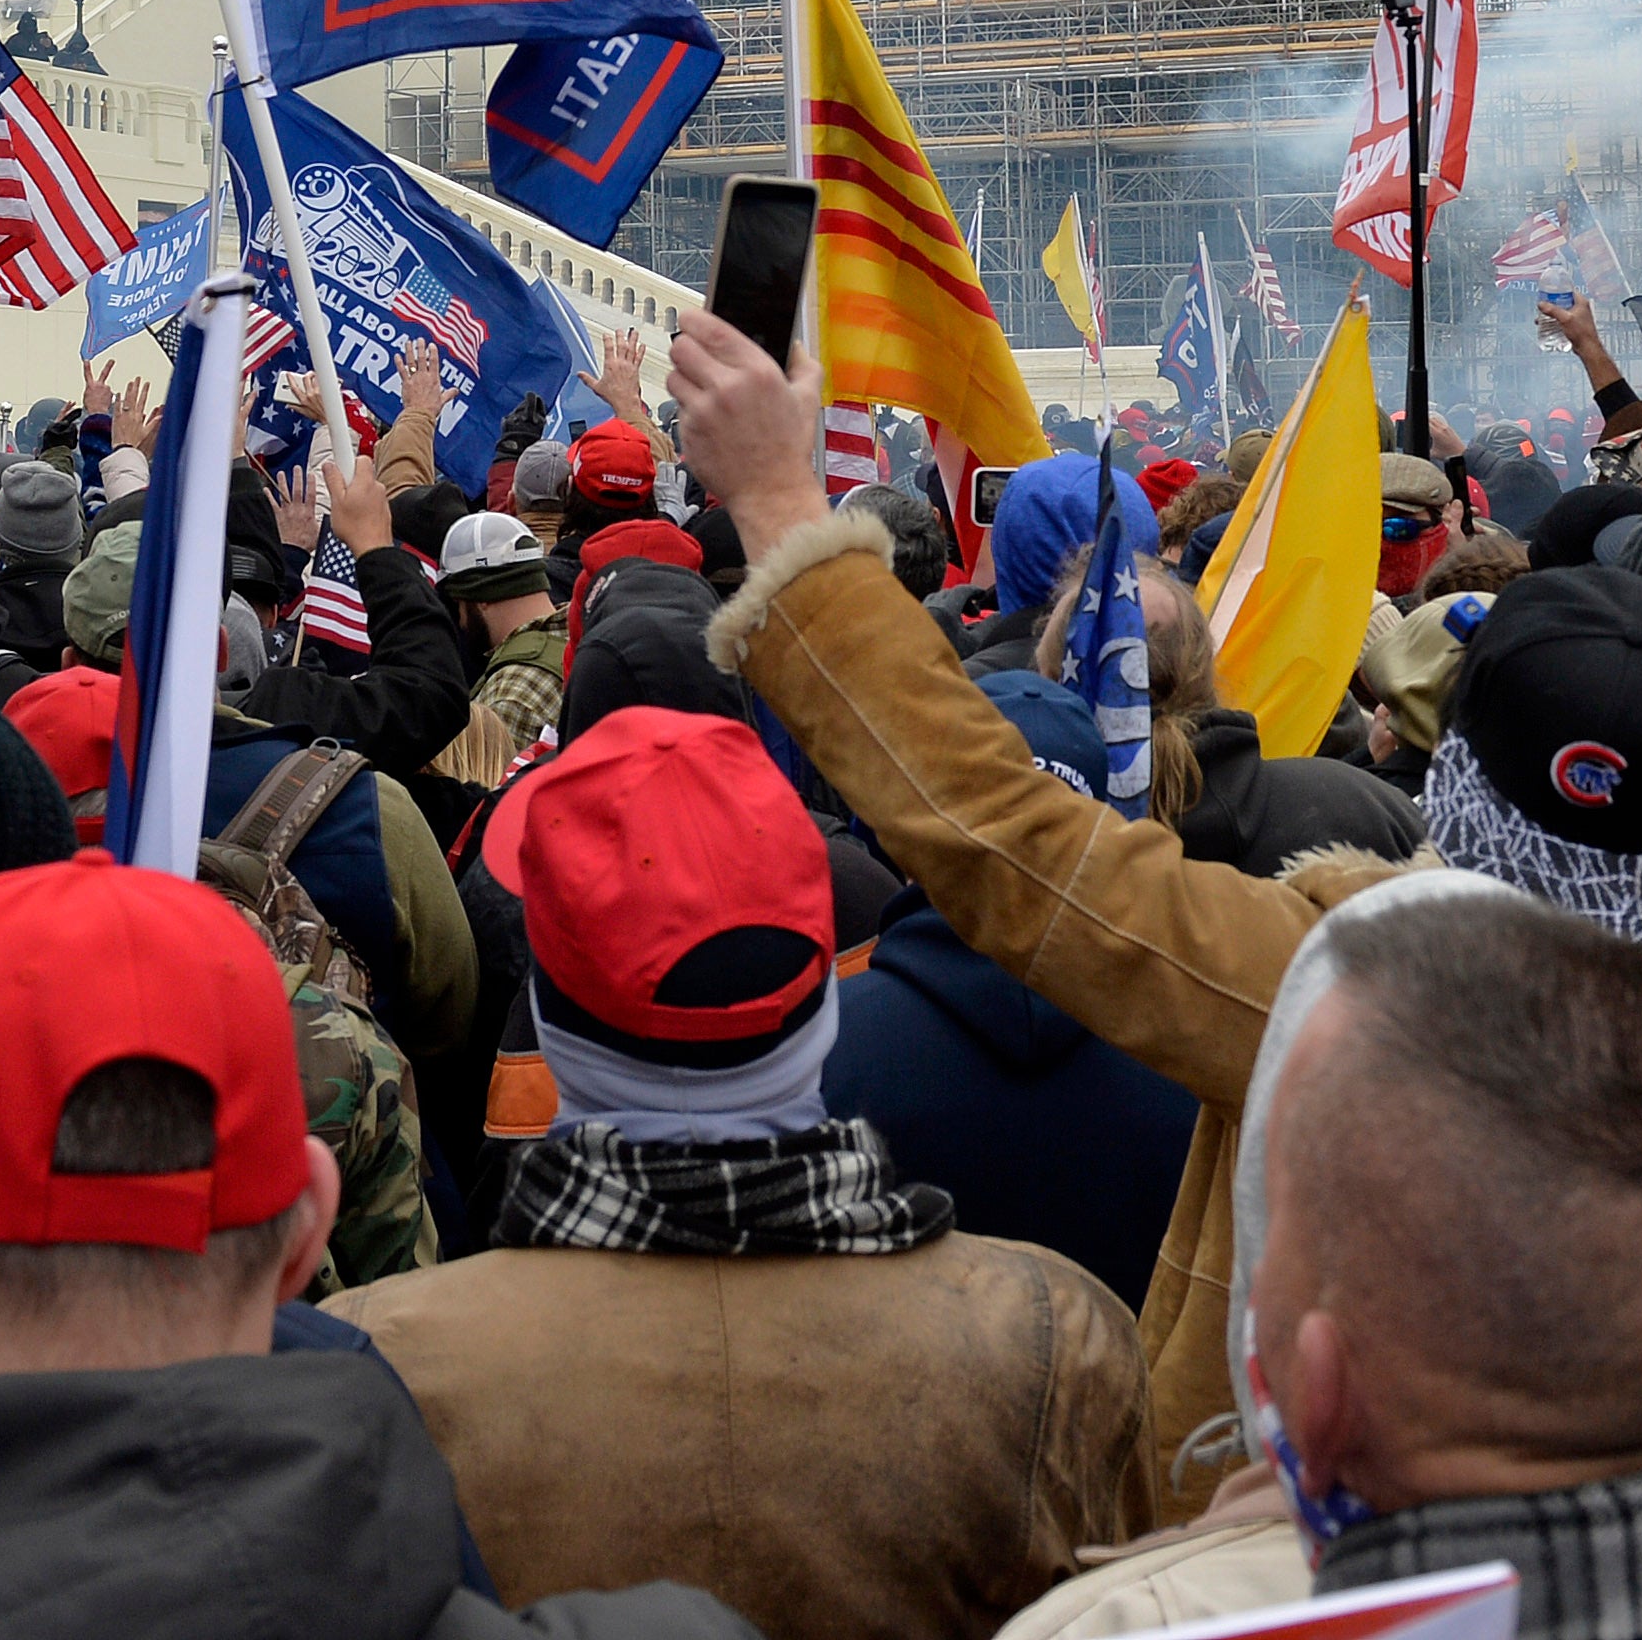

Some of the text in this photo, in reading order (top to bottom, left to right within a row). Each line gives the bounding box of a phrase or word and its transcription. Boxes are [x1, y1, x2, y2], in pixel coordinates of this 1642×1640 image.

[313, 234, 402, 300] 2020
[315, 281, 346, 314] ALL
[440, 358, 476, 397] THE
